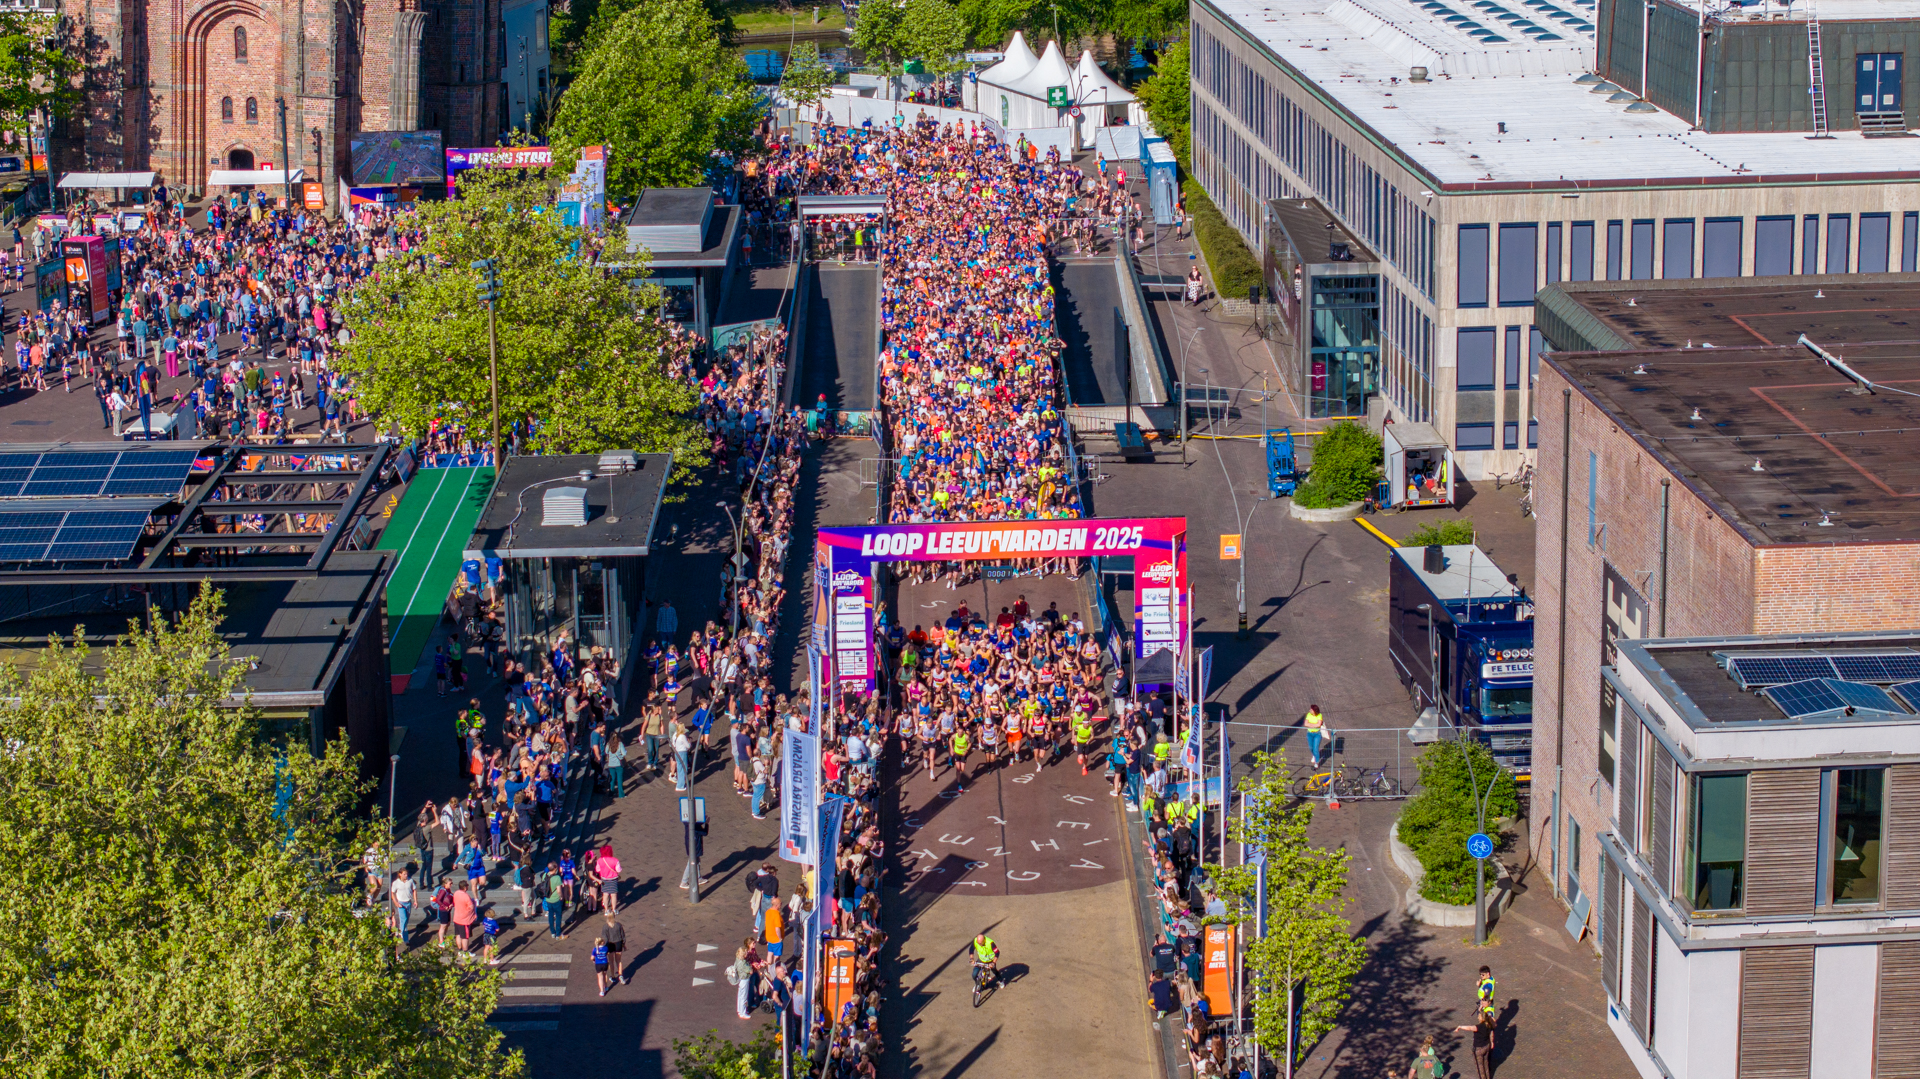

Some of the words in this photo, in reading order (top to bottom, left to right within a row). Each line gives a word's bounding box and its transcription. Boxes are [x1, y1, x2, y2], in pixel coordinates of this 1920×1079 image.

[861, 533, 923, 556] LOOP
[926, 528, 1088, 554] LEEUWARDEN
[1093, 526, 1143, 550] 2025
